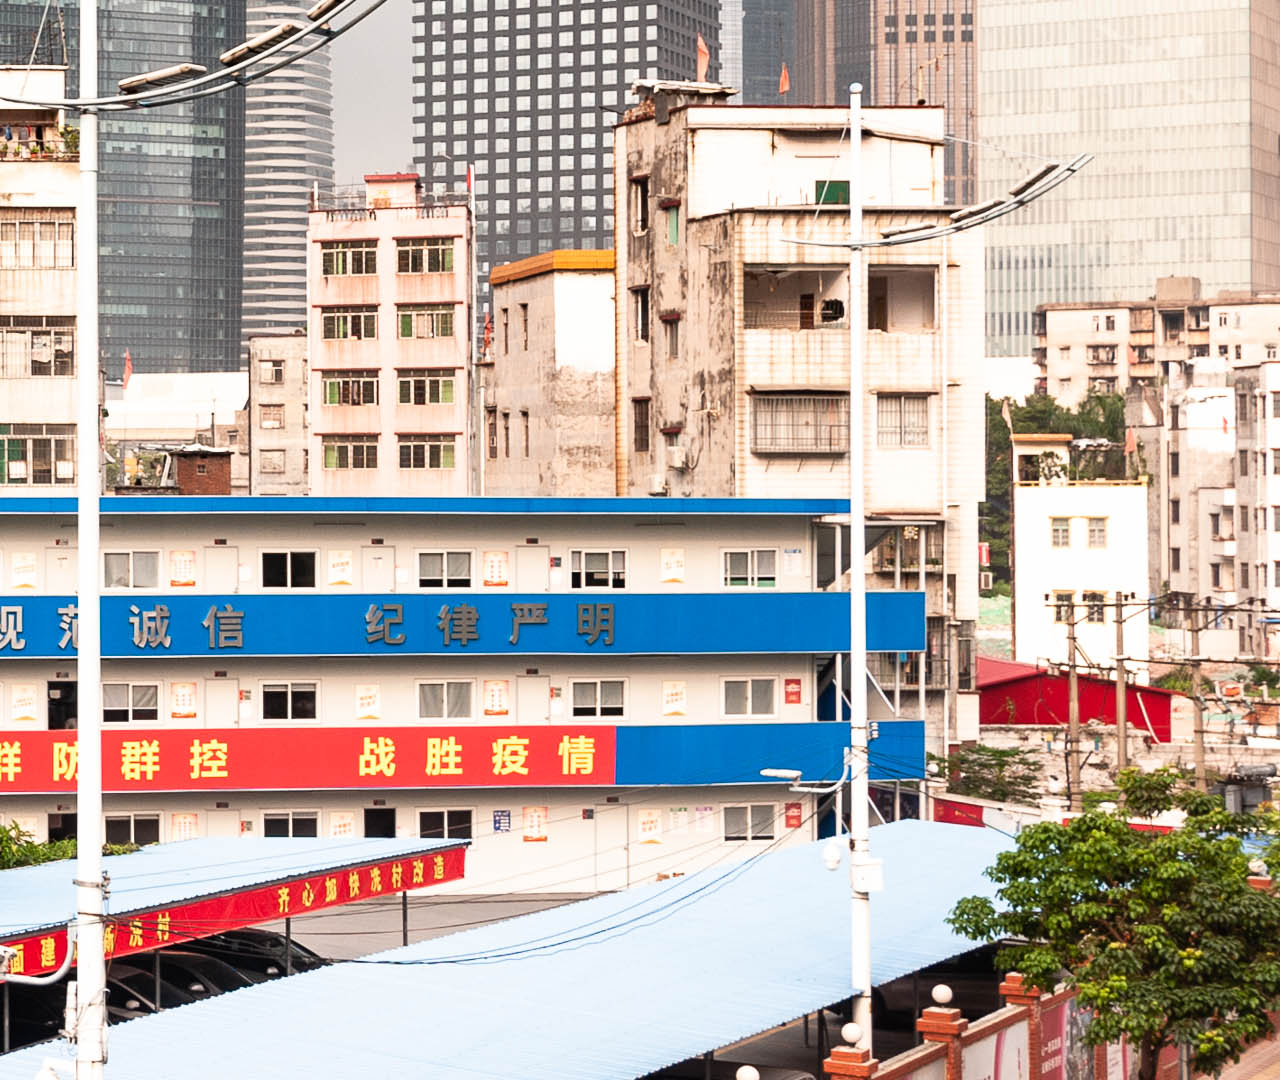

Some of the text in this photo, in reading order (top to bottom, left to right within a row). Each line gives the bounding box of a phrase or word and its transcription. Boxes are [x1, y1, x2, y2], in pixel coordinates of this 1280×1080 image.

[365, 602, 616, 646] 纪律严明
[358, 735, 597, 777] 战胜疫情
